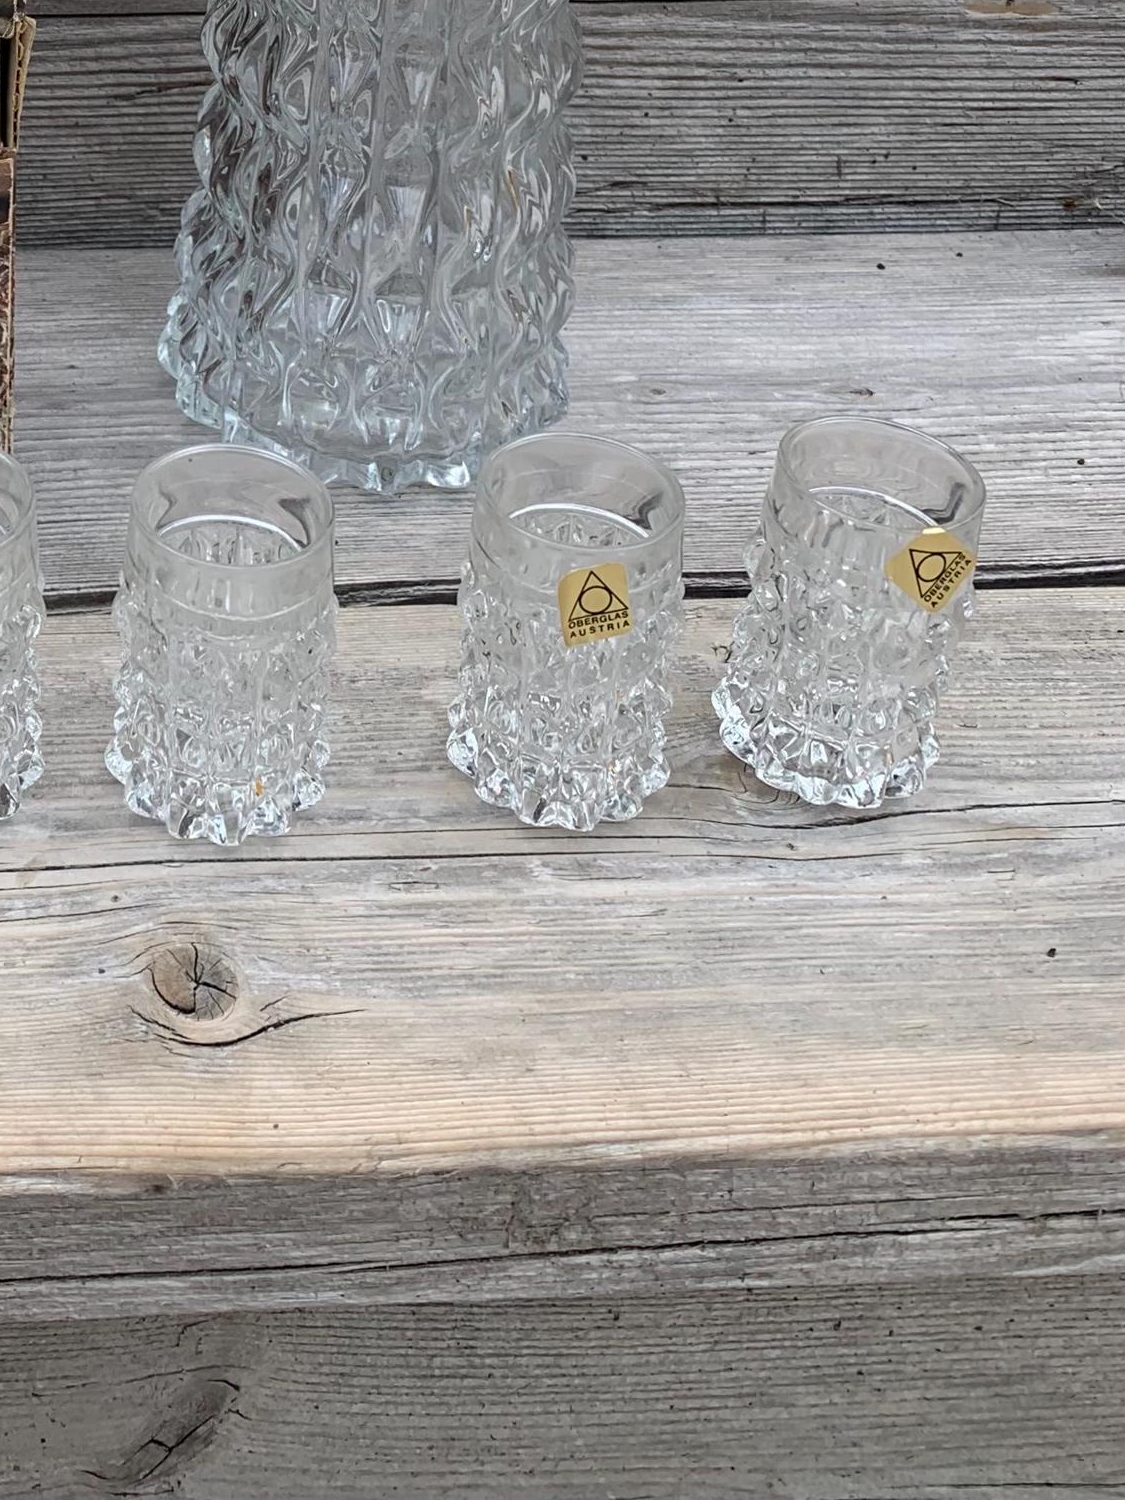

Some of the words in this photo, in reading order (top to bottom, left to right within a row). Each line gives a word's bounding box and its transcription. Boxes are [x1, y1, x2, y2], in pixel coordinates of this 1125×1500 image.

[923, 551, 967, 603] OBERGLAS
[930, 558, 972, 609] AUSTRIA
[568, 610, 630, 630] OBERGLAS
[569, 619, 631, 639] AUSTRIA
